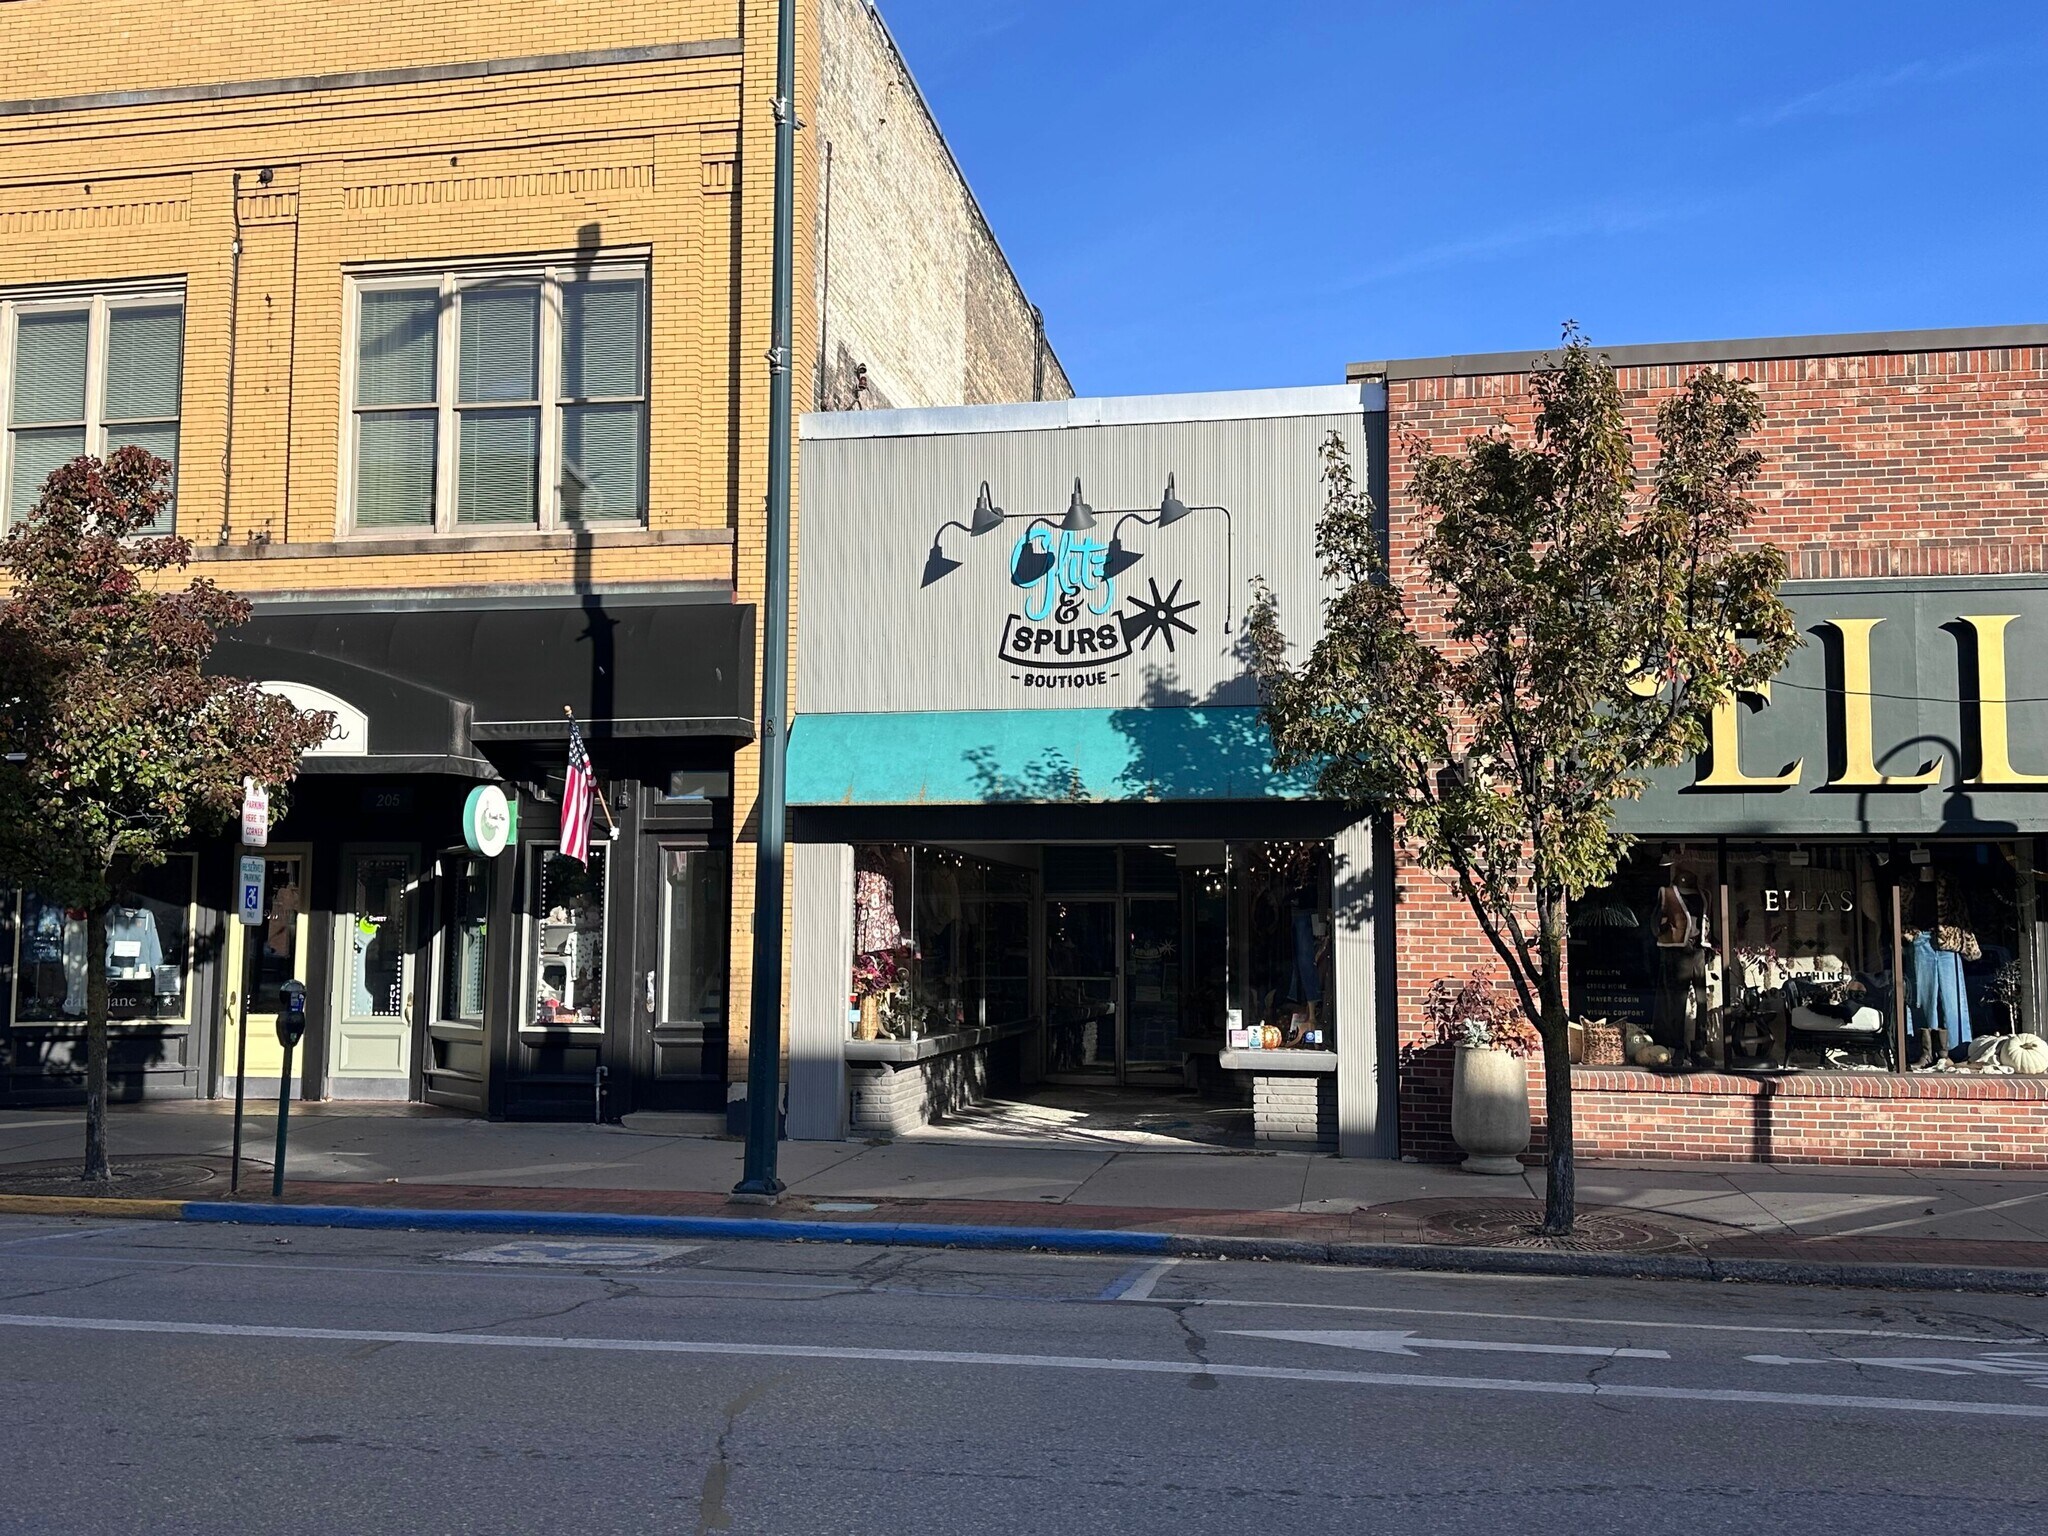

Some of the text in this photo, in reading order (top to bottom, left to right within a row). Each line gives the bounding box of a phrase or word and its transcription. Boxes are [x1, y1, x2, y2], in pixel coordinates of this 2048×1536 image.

[1011, 528, 1115, 621] Glitz
[1055, 586, 1084, 624] &
[1012, 624, 1118, 655] SPURS
[1023, 671, 1108, 689] BOUTIQUE
[246, 801, 265, 810] PARKING
[376, 794, 400, 807] 205
[245, 814, 265, 823] HERE TO
[245, 827, 264, 837] CORNER
[242, 863, 264, 872] RESERVED
[243, 874, 262, 883] PARKING
[1765, 890, 1853, 912] ELLA'S
[1779, 972, 1844, 981] CLOTHING
[107, 993, 137, 1010] jane
[1613, 1009, 1645, 1017] COMFORT
